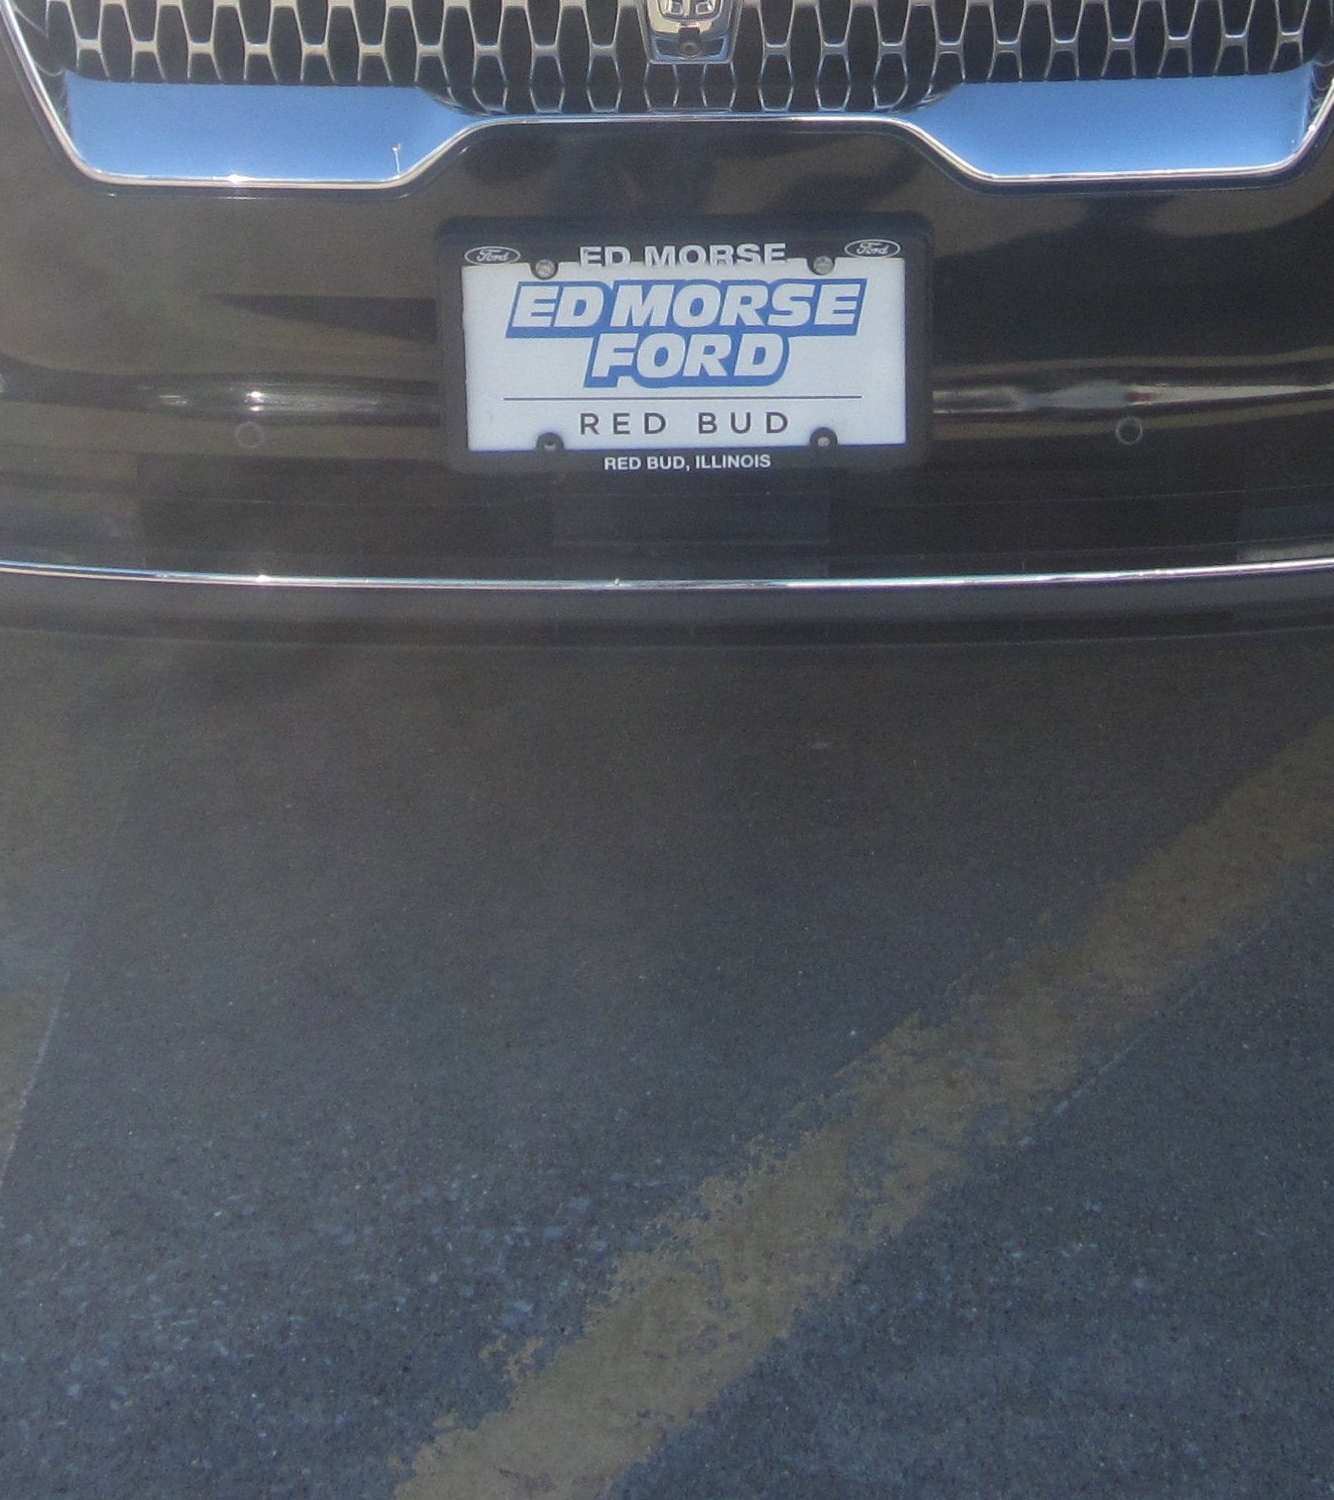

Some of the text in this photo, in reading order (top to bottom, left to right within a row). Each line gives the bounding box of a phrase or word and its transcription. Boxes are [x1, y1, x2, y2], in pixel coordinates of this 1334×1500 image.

[476, 249, 509, 261] Ford
[579, 244, 786, 267] ED MORSE
[856, 242, 889, 254] Ford
[591, 333, 784, 378] FORD
[580, 411, 789, 435] RED BUD
[604, 454, 771, 471] RED BUD, ILLINOIS
